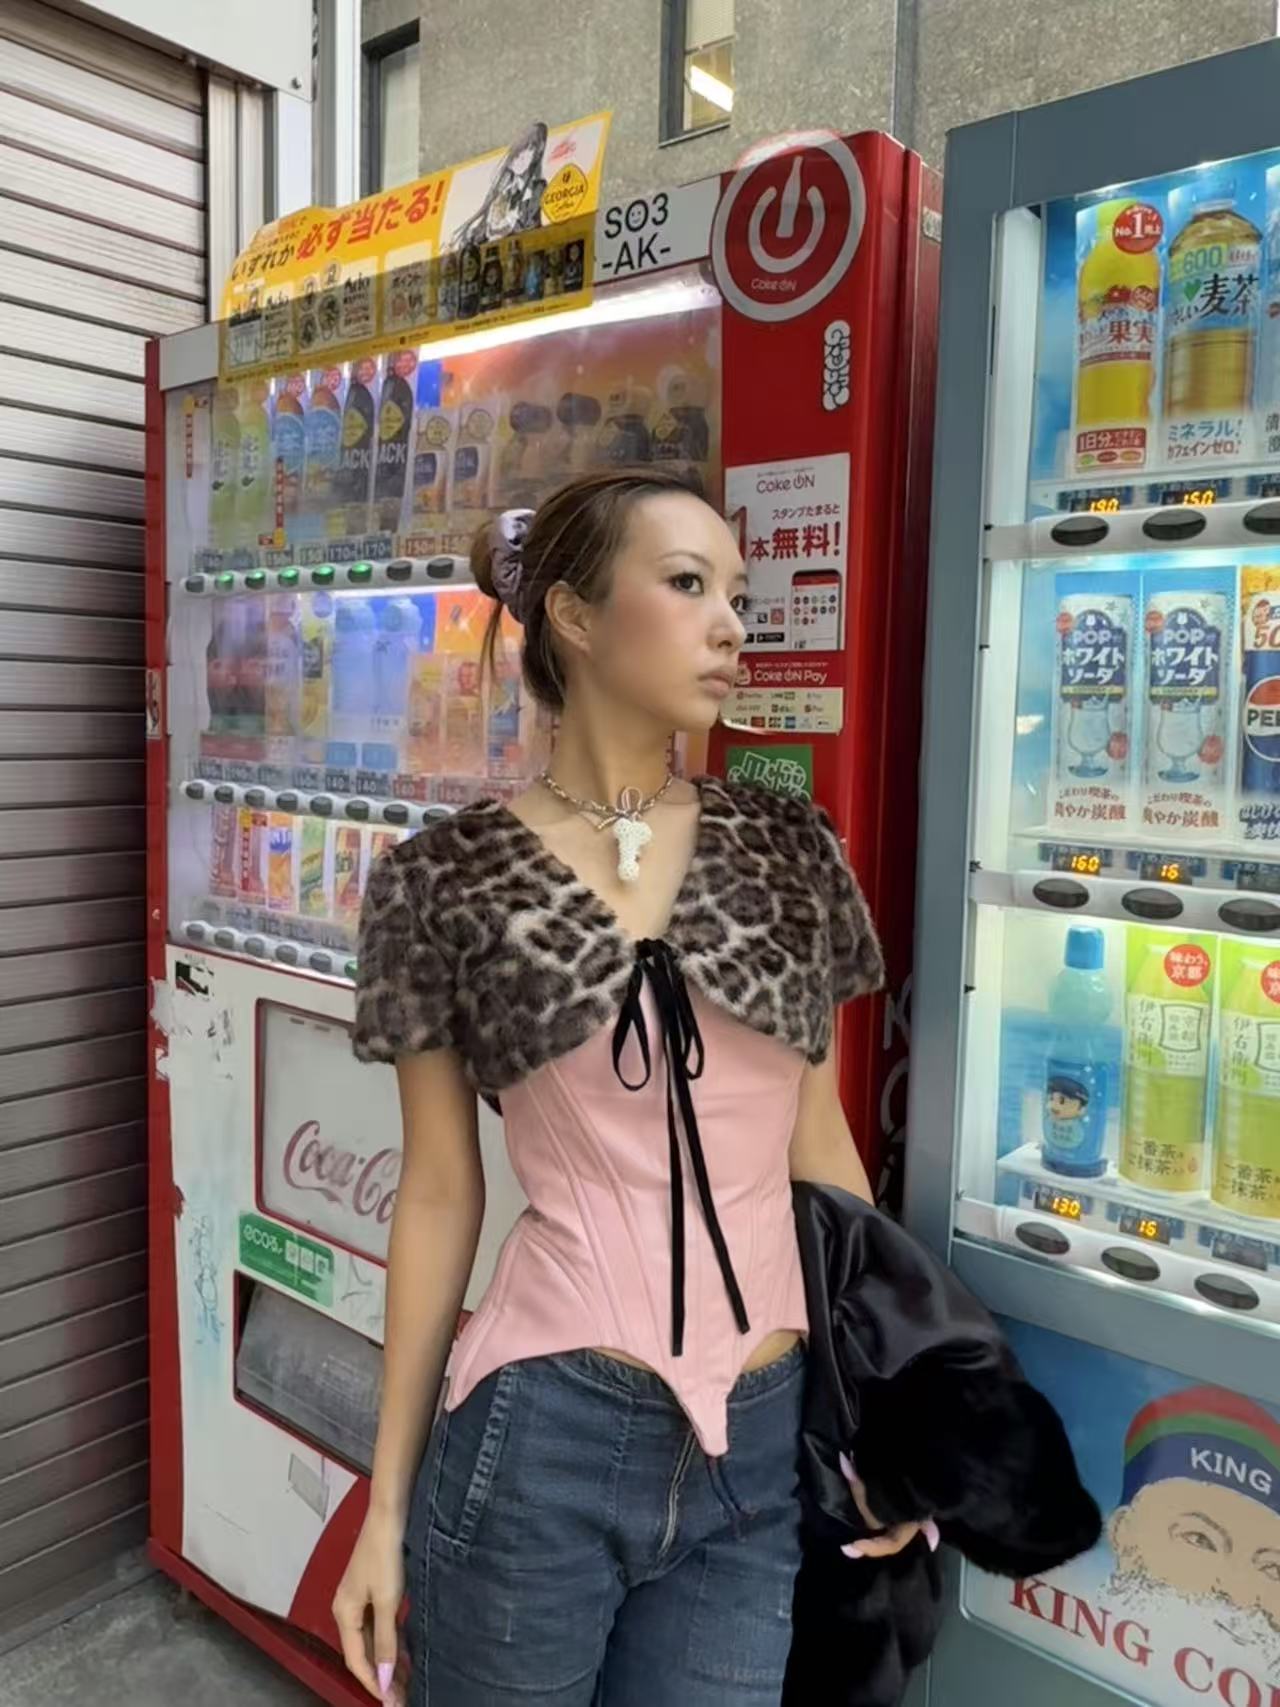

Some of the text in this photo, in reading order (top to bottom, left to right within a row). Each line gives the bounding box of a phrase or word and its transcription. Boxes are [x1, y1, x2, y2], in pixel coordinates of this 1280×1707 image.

[602, 232, 671, 274] -AK-
[1183, 245, 1222, 274] 600
[756, 474, 815, 494] Coke ON
[772, 504, 841, 520] スタンプたまると
[1062, 646, 1126, 667] ホワイト
[1152, 646, 1218, 667] ホワイト
[754, 667, 828, 685] Coke ON Pay
[1068, 664, 1119, 685] ソーダ
[1159, 664, 1213, 686] ソーダ
[1071, 854, 1099, 873] 160
[1052, 1197, 1081, 1217] 130
[1190, 1446, 1272, 1496] KING
[1009, 1576, 1154, 1667] KING
